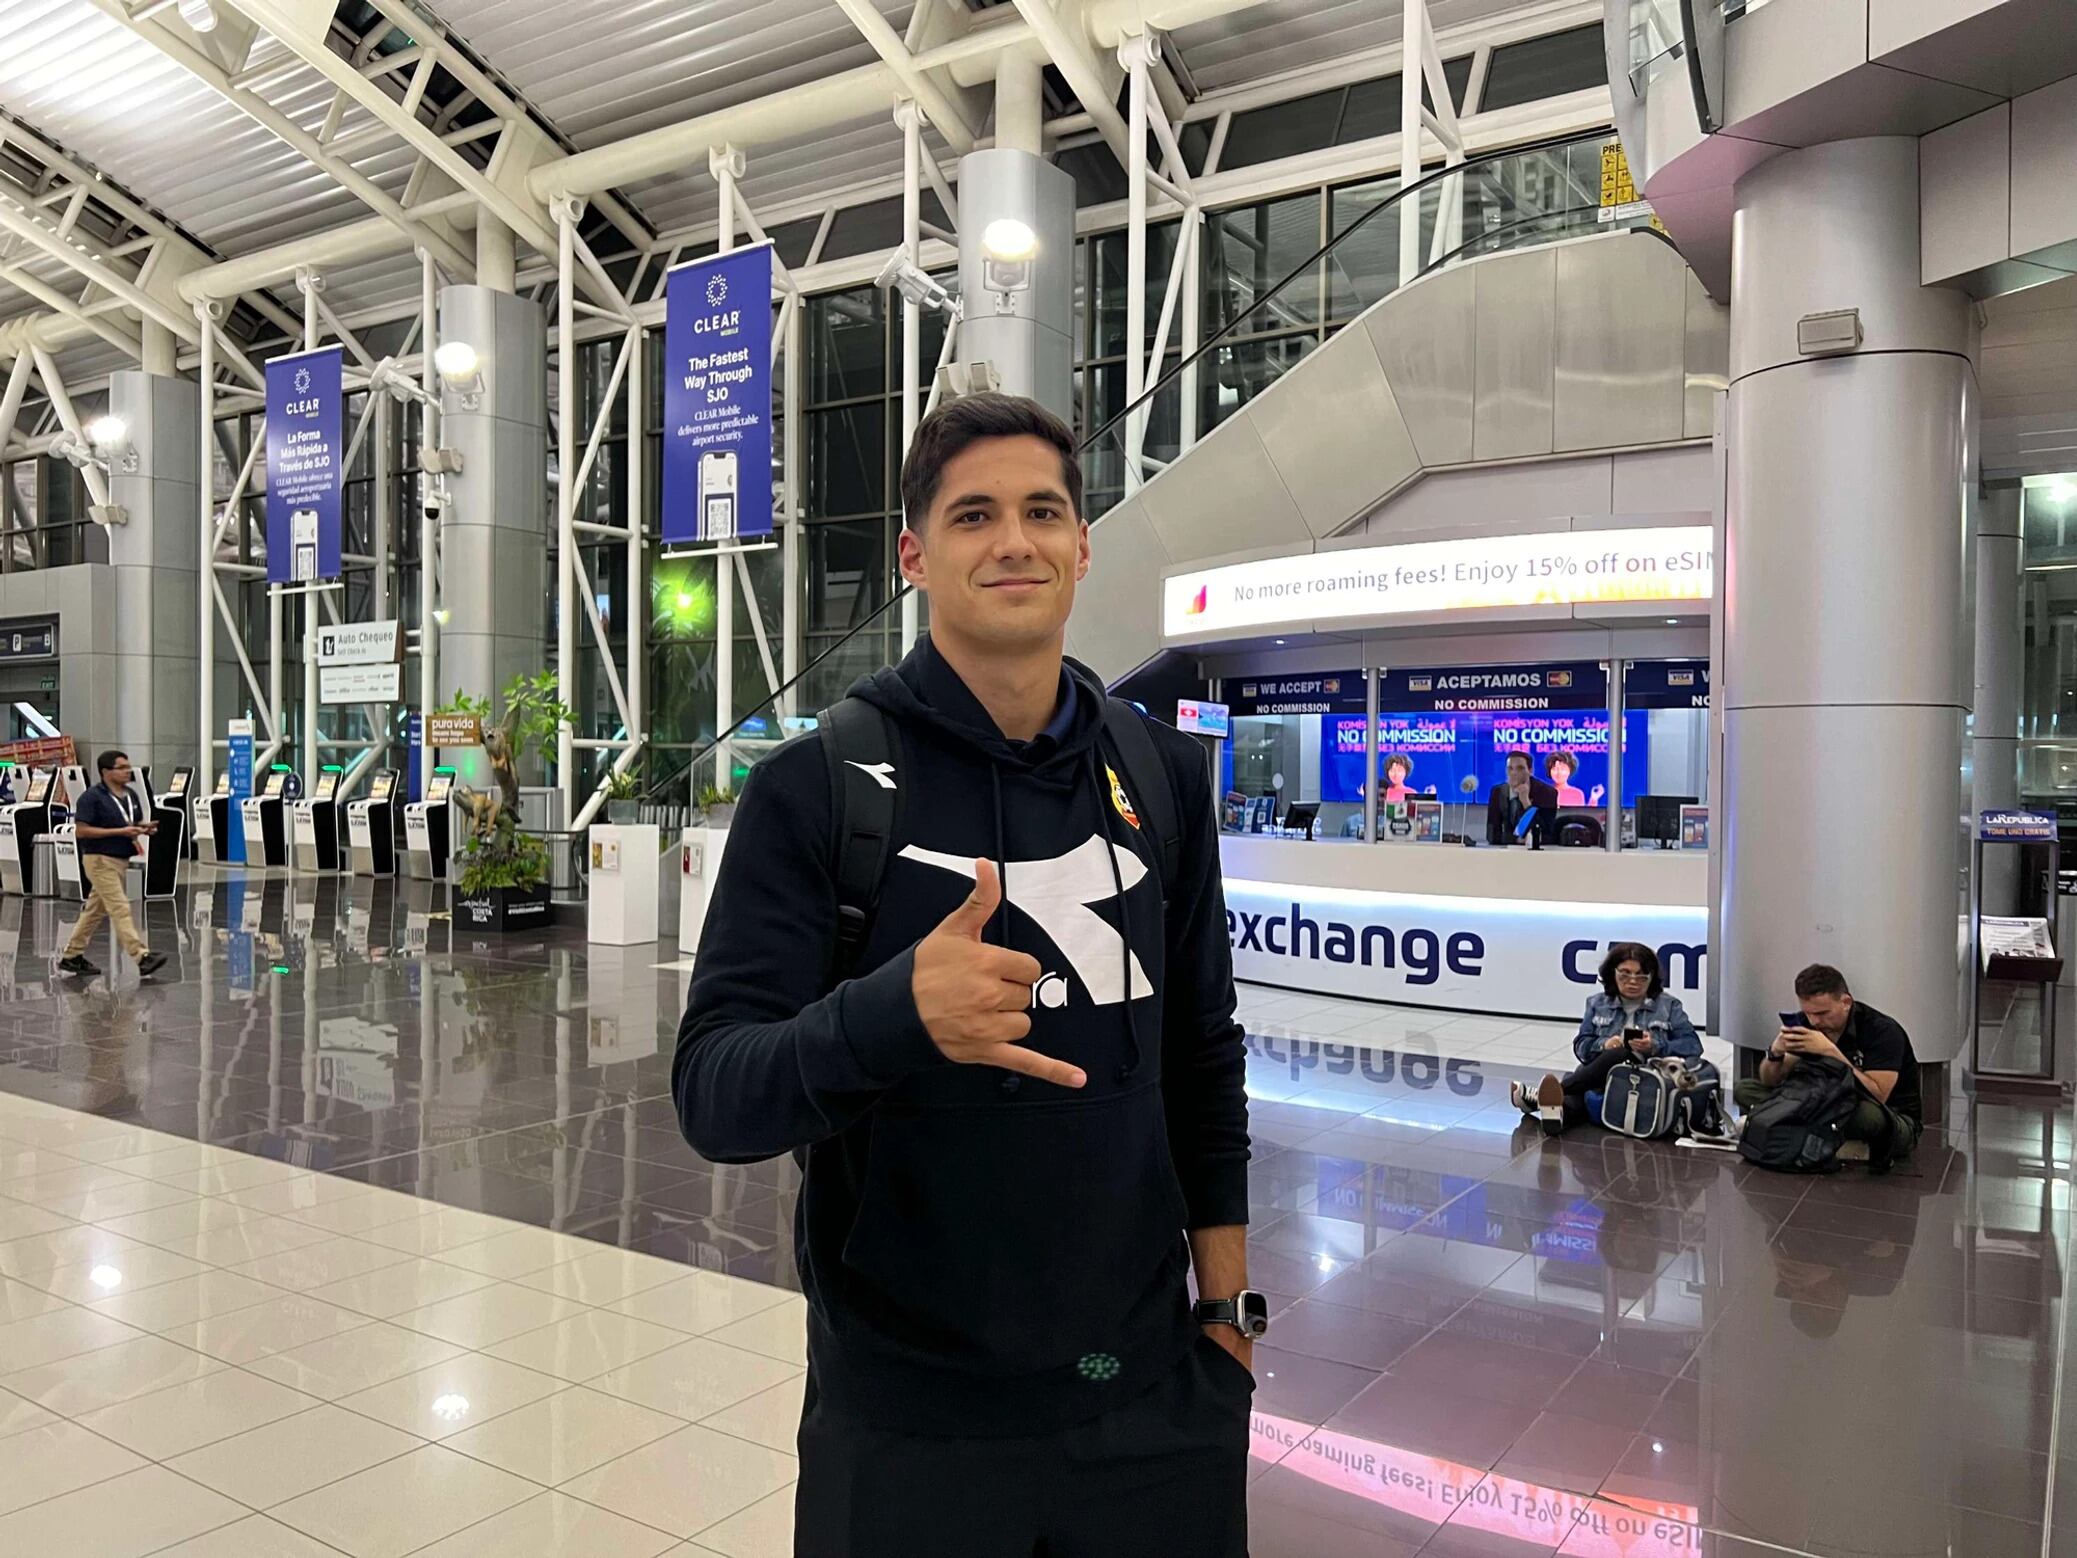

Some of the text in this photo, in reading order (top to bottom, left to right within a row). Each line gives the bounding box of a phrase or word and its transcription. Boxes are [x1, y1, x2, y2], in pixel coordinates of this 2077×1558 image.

[694, 311, 740, 334] CLEAR
[688, 347, 749, 371] The Fastest
[684, 365, 753, 390] Way Through
[707, 387, 729, 403] SJO
[286, 399, 319, 415] CLEAR
[694, 404, 741, 421] CLEAR Mobile
[677, 413, 759, 437] delivers more predictable
[287, 430, 321, 445] La Forma
[692, 430, 743, 447] airport security.
[280, 443, 328, 459] Más Rápida a
[279, 455, 330, 474] Través de SJO
[1234, 586, 1254, 602] No
[1259, 580, 1301, 599] more
[1307, 570, 1389, 592] roaming
[1395, 564, 1446, 586] fees!
[1455, 560, 1518, 584] Enjoy
[1526, 556, 1577, 577] 15%
[1585, 552, 1620, 575] off
[1626, 555, 1656, 573] on
[338, 632, 394, 645] Auto Chequeo
[1260, 683, 1276, 695] WE
[1278, 681, 1322, 694] ACCEPT
[1436, 673, 1541, 690] ACEPTAMOS
[1256, 703, 1330, 714] NO COMMISSION
[1434, 697, 1549, 711] NO COMMISSION
[432, 718, 474, 730] pura vida
[1552, 719, 1574, 729] YOK
[1338, 729, 1360, 743] NO
[1494, 728, 1518, 744] NO
